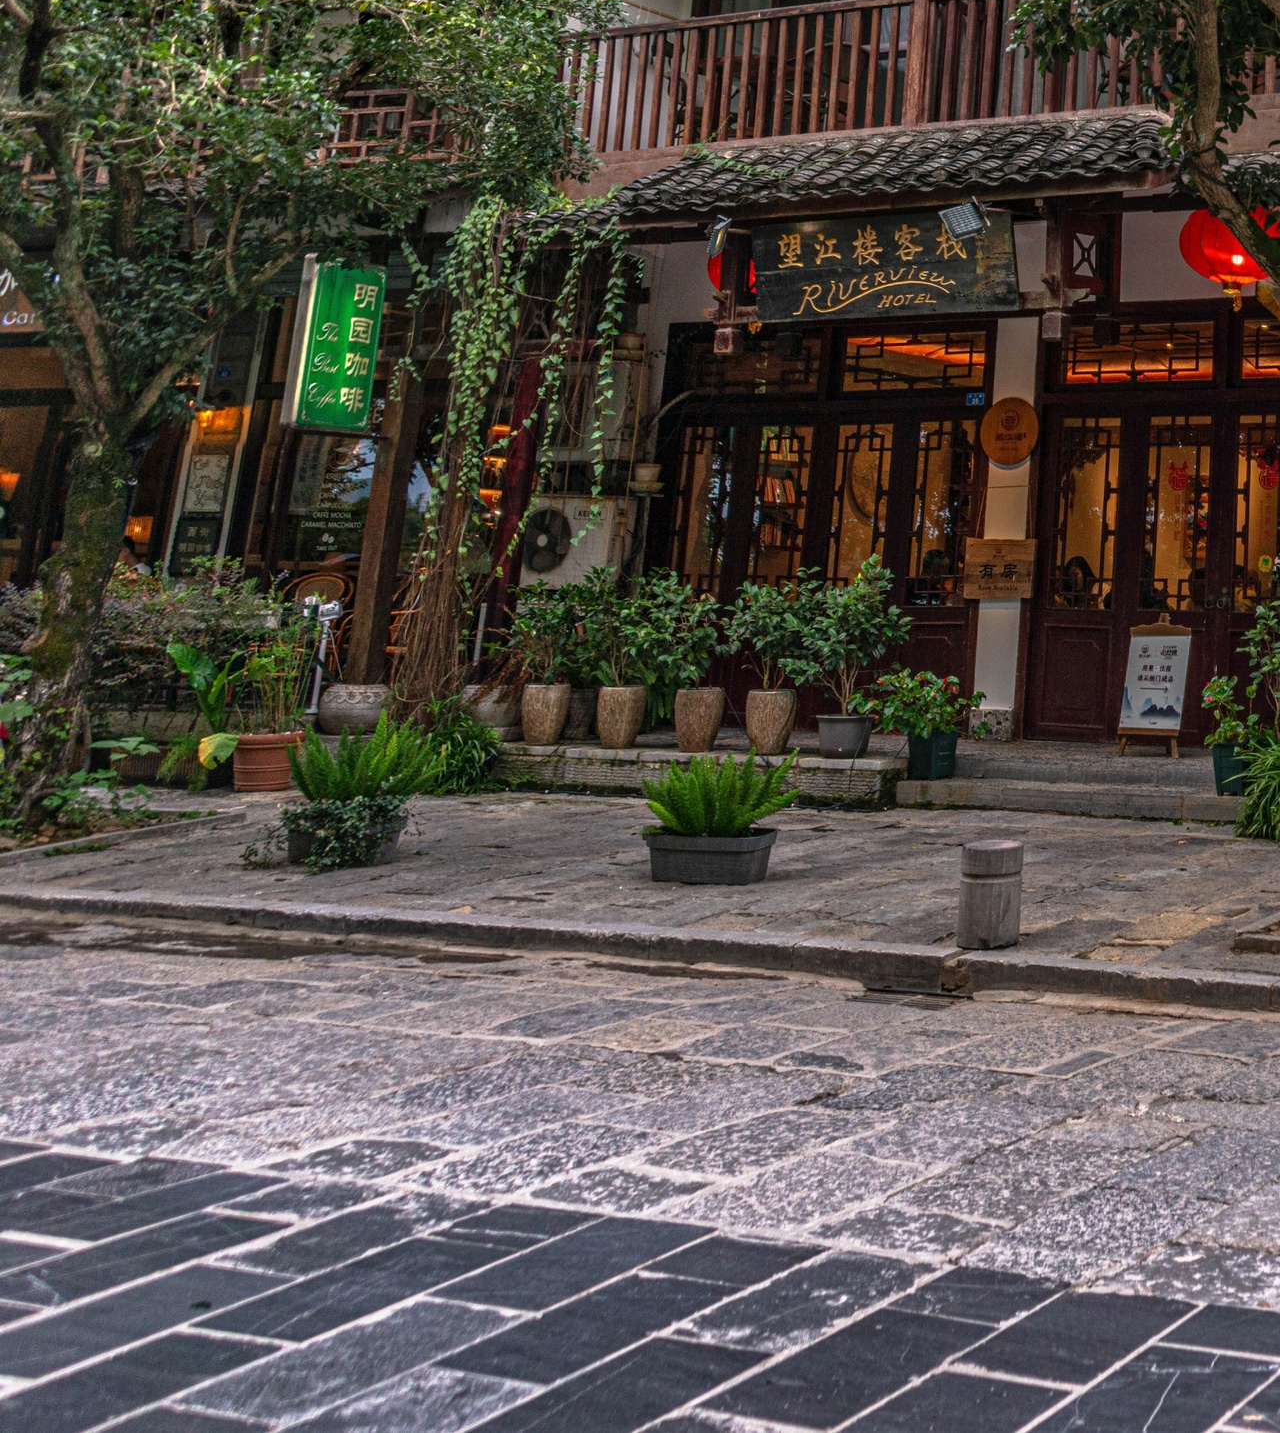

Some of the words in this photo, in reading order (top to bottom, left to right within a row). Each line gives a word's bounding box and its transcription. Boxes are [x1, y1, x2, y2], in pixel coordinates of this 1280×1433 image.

[777, 224, 968, 269] 望江楼客栈
[877, 293, 937, 308] HOTEL
[316, 322, 340, 343] The
[340, 282, 378, 413] 明园咖啡
[312, 352, 340, 374] Best
[308, 382, 337, 409] Coffee
[979, 563, 1018, 579] 有房
